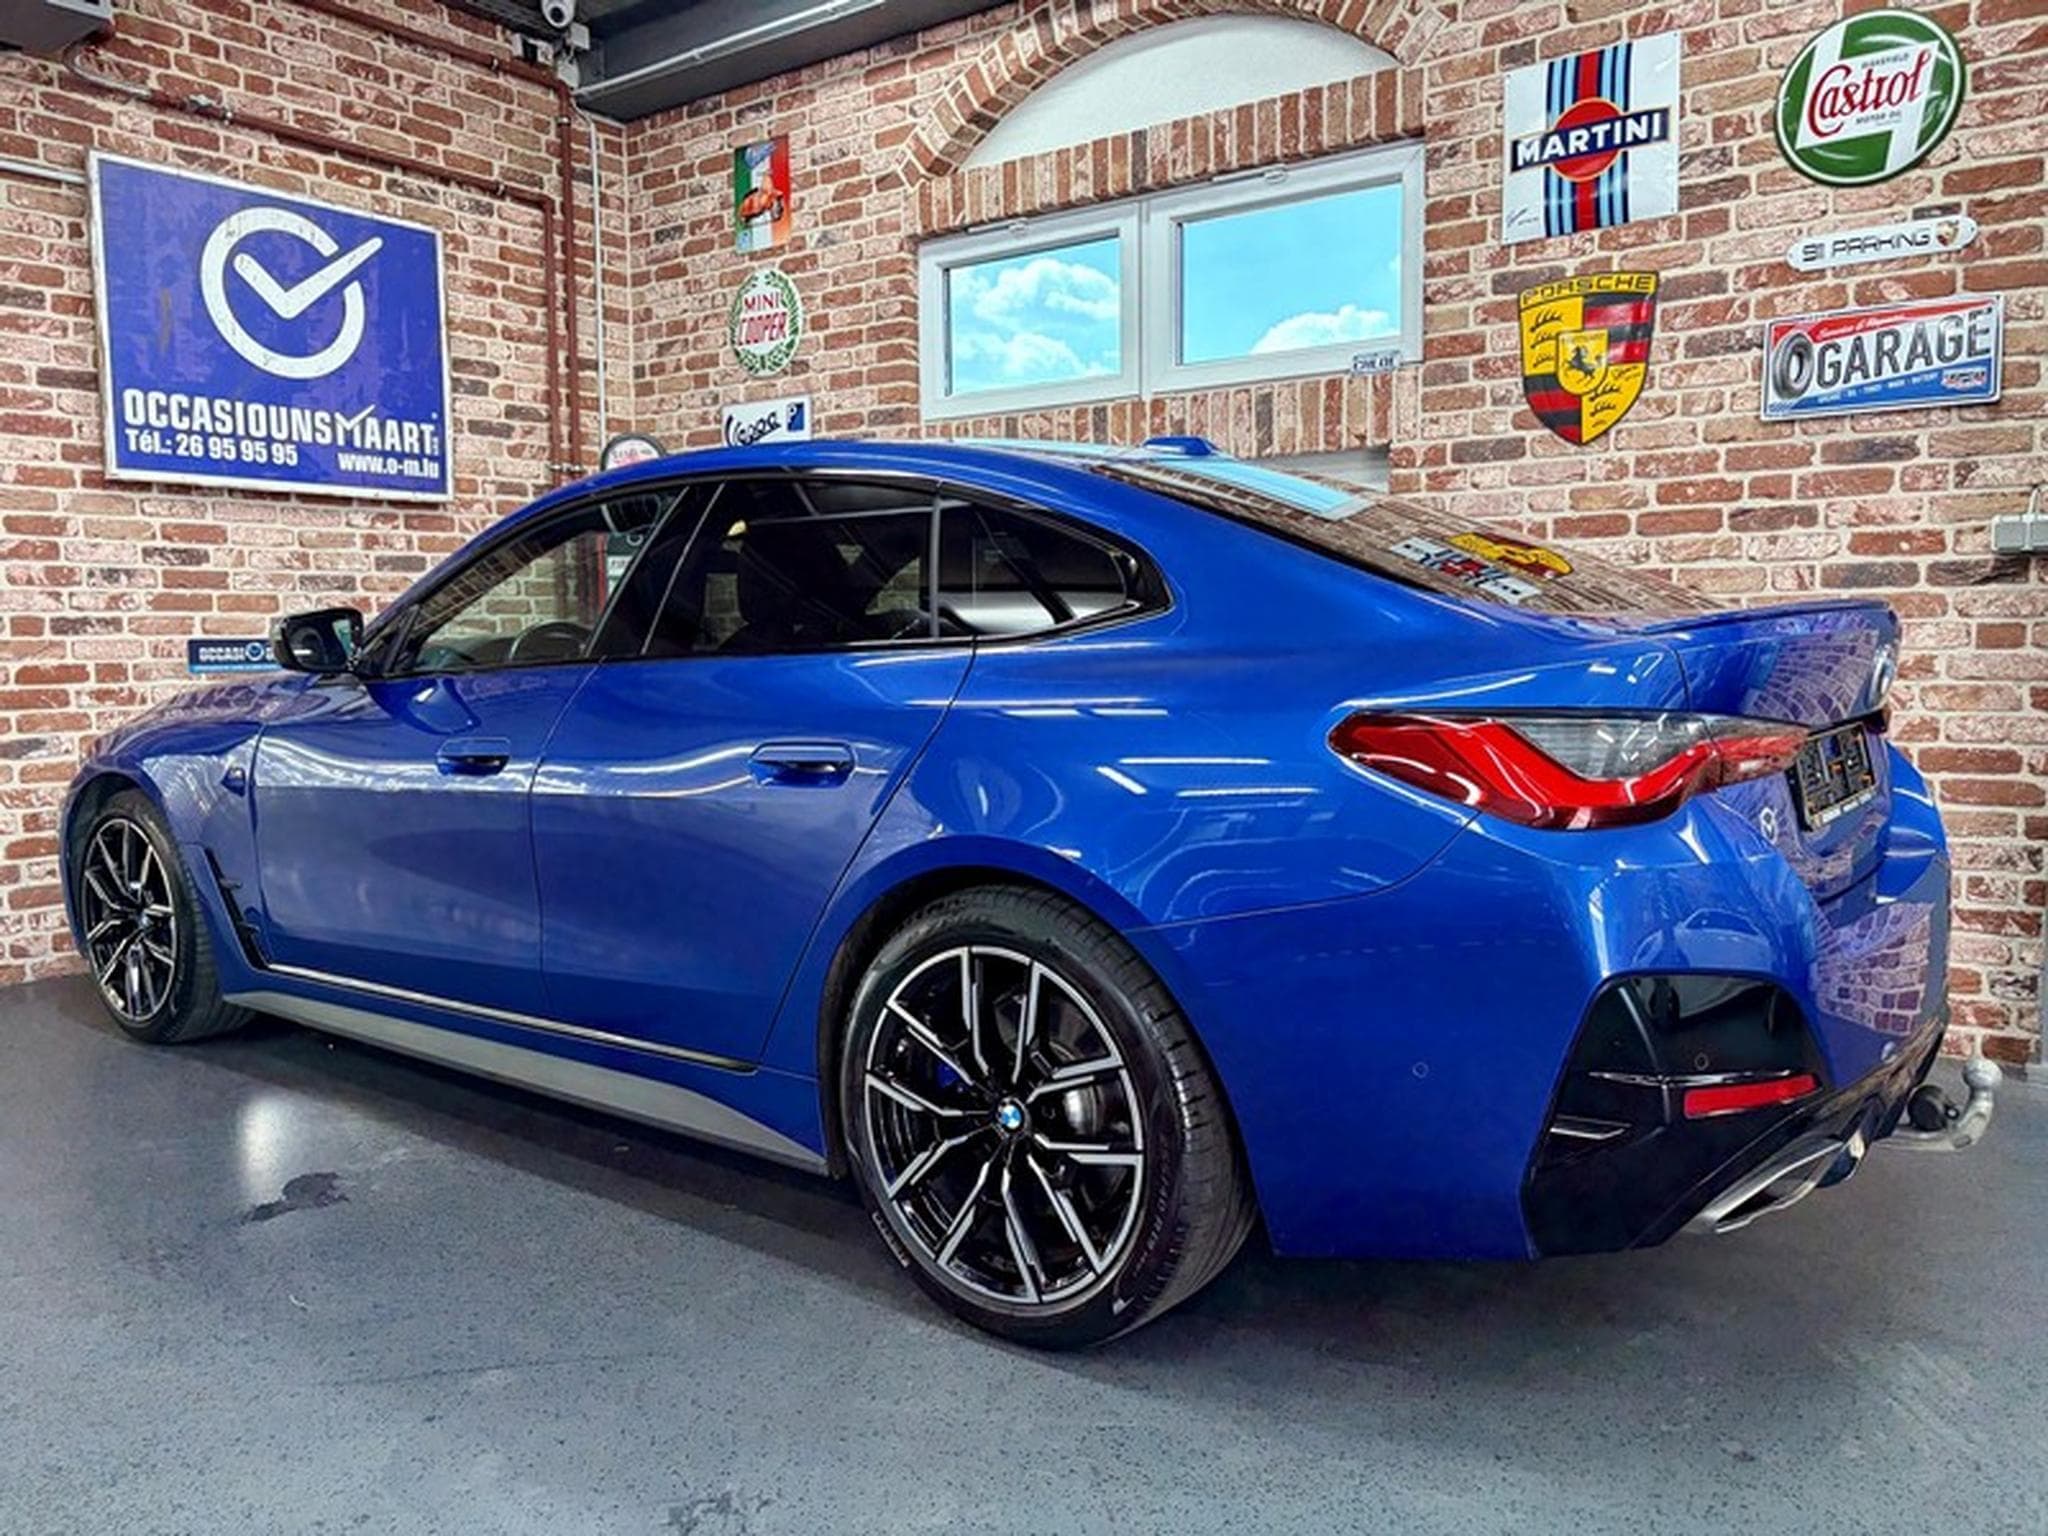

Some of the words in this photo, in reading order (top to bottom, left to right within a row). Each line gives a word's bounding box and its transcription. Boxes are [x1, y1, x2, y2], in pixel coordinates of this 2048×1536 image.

[1807, 48, 1932, 138] Castrol
[1516, 112, 1662, 167] MARTINI
[1832, 227, 1931, 258] PARKING
[744, 291, 779, 313] MINI
[1523, 275, 1652, 305] PORSCHE
[737, 311, 787, 346] COOPER
[1816, 307, 1993, 389] GARAGE
[175, 432, 204, 458] 26
[208, 436, 237, 461] 95
[240, 440, 268, 463] 95
[271, 442, 298, 466] 95
[337, 452, 440, 480] www.o-m.lu
